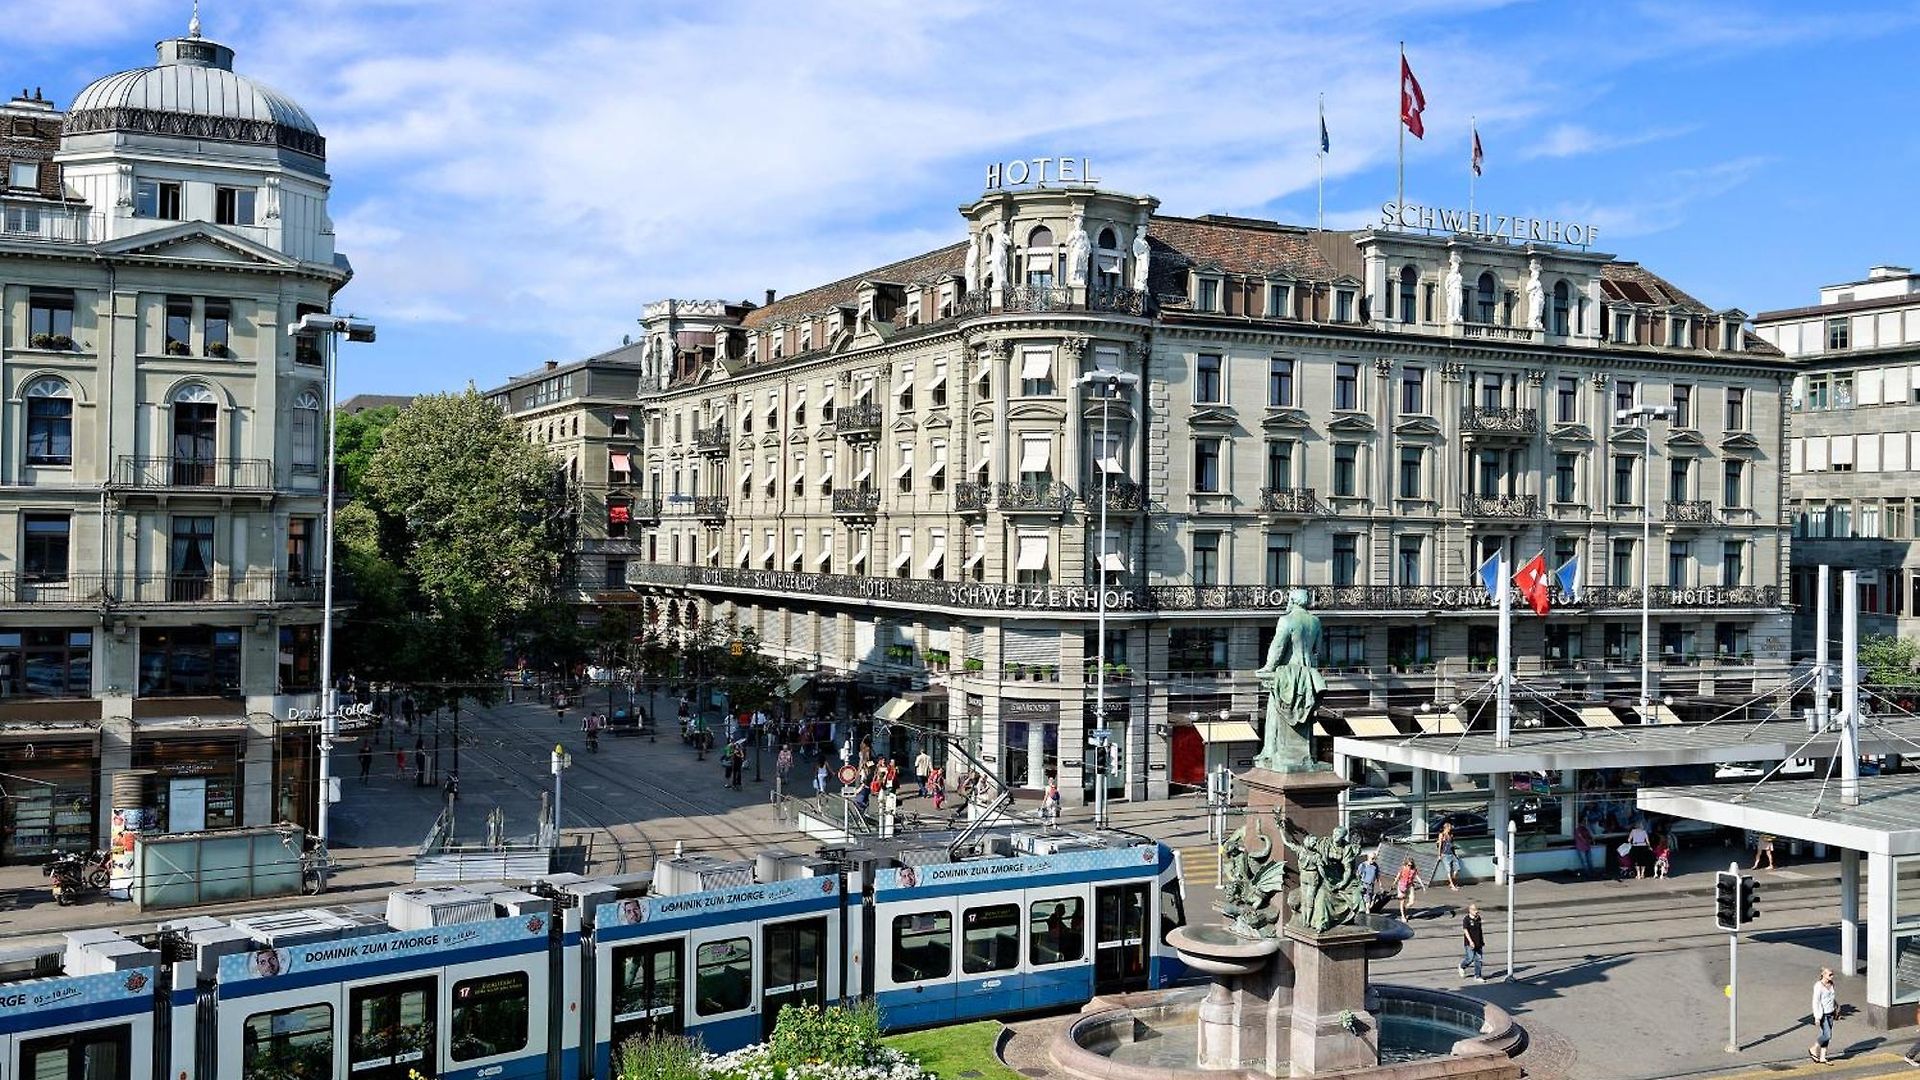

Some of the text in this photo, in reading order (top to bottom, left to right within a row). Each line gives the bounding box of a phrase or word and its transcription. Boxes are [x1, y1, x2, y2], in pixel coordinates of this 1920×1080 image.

[986, 157, 1100, 190] HOTEL
[1381, 201, 1599, 246] SCHWEIZERHOF
[754, 573, 818, 591] SCHWEIZERHOF
[860, 581, 1134, 608] HOTEL SCHWEIZERHOF
[1254, 589, 1320, 607] HOL
[1671, 590, 1729, 605] HOTEL
[931, 868, 969, 880] DOMINIK
[971, 866, 989, 876] ZUM
[990, 862, 1024, 875] ZMORGE
[661, 899, 702, 913] DOMINIK
[705, 896, 724, 907] ZUM
[726, 890, 765, 904] ZMORGE
[968, 913, 977, 922] 17
[305, 946, 358, 963] DOMINIK
[361, 942, 388, 955] ZUM
[391, 934, 439, 951] ZMORGE
[33, 995, 43, 1004] 05
[460, 986, 471, 998] 17
